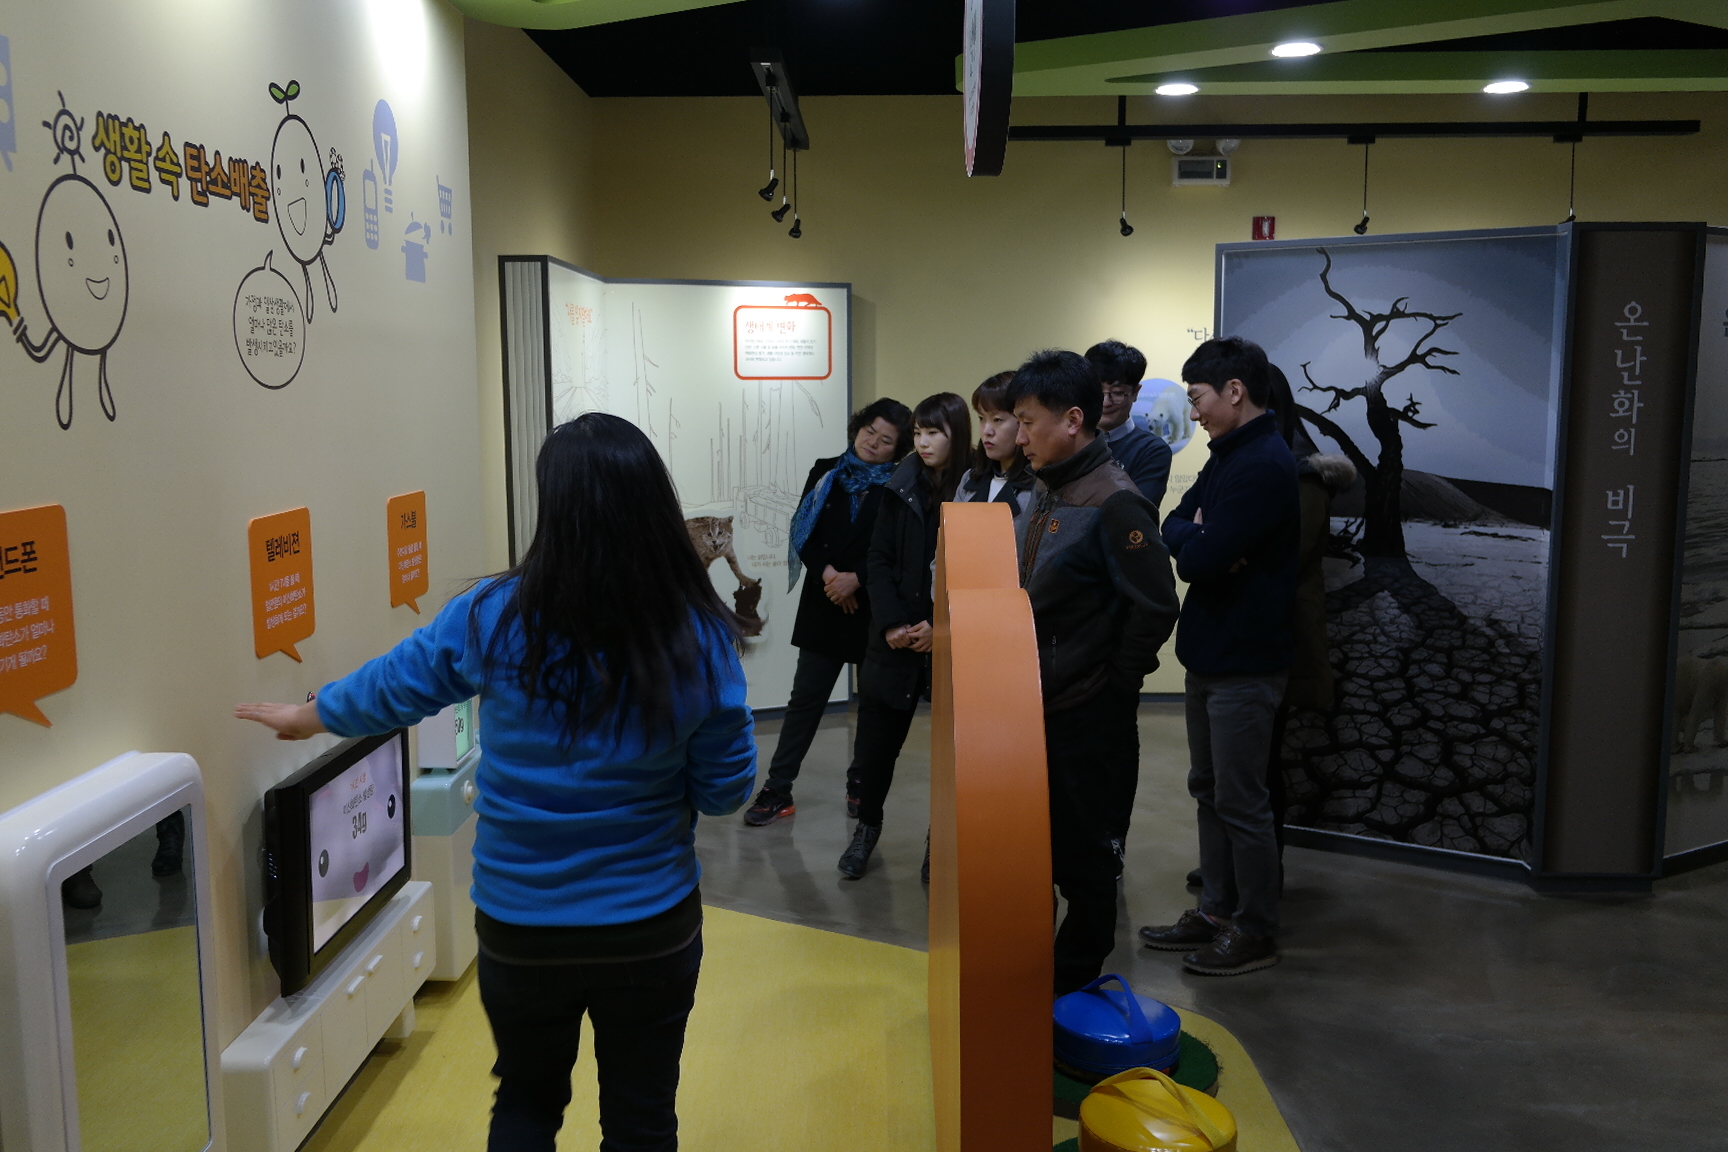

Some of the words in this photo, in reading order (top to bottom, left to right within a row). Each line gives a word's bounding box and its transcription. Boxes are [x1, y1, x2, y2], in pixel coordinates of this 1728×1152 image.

[92, 111, 152, 194] 생활
[154, 131, 183, 202] 속
[184, 141, 271, 224] 탄소배출
[245, 294, 263, 313] 가정과
[263, 296, 295, 316] 일상생활에서
[248, 316, 266, 335] 얼마나
[266, 317, 278, 336] 많은
[278, 319, 294, 337] 탄소를
[745, 320, 774, 335] 생태계
[776, 320, 796, 335] 변화
[1609, 301, 1650, 456] 온난화의
[401, 511, 416, 529] 가스불
[1601, 484, 1636, 558] 비극
[14, 598, 39, 619] 통화할
[40, 595, 50, 612] 때
[30, 619, 55, 640] 얼마나
[18, 645, 47, 667] 될까요?
[352, 811, 367, 840] 34g
